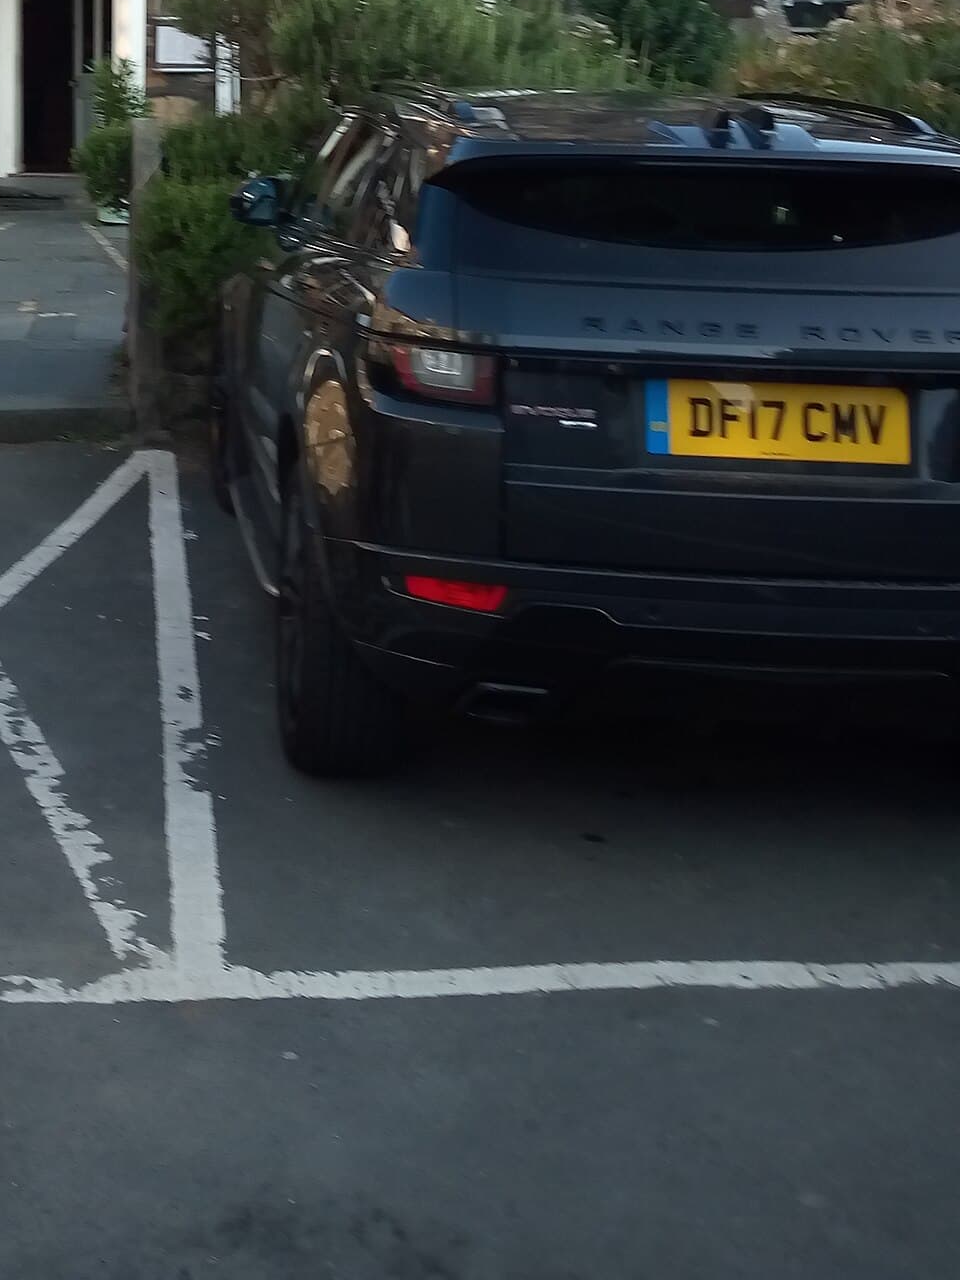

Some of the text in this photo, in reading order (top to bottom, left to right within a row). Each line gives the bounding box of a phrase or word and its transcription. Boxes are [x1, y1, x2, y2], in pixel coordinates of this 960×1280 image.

[581, 316, 761, 339] RANGE
[688, 396, 887, 446] DF17 CMV
